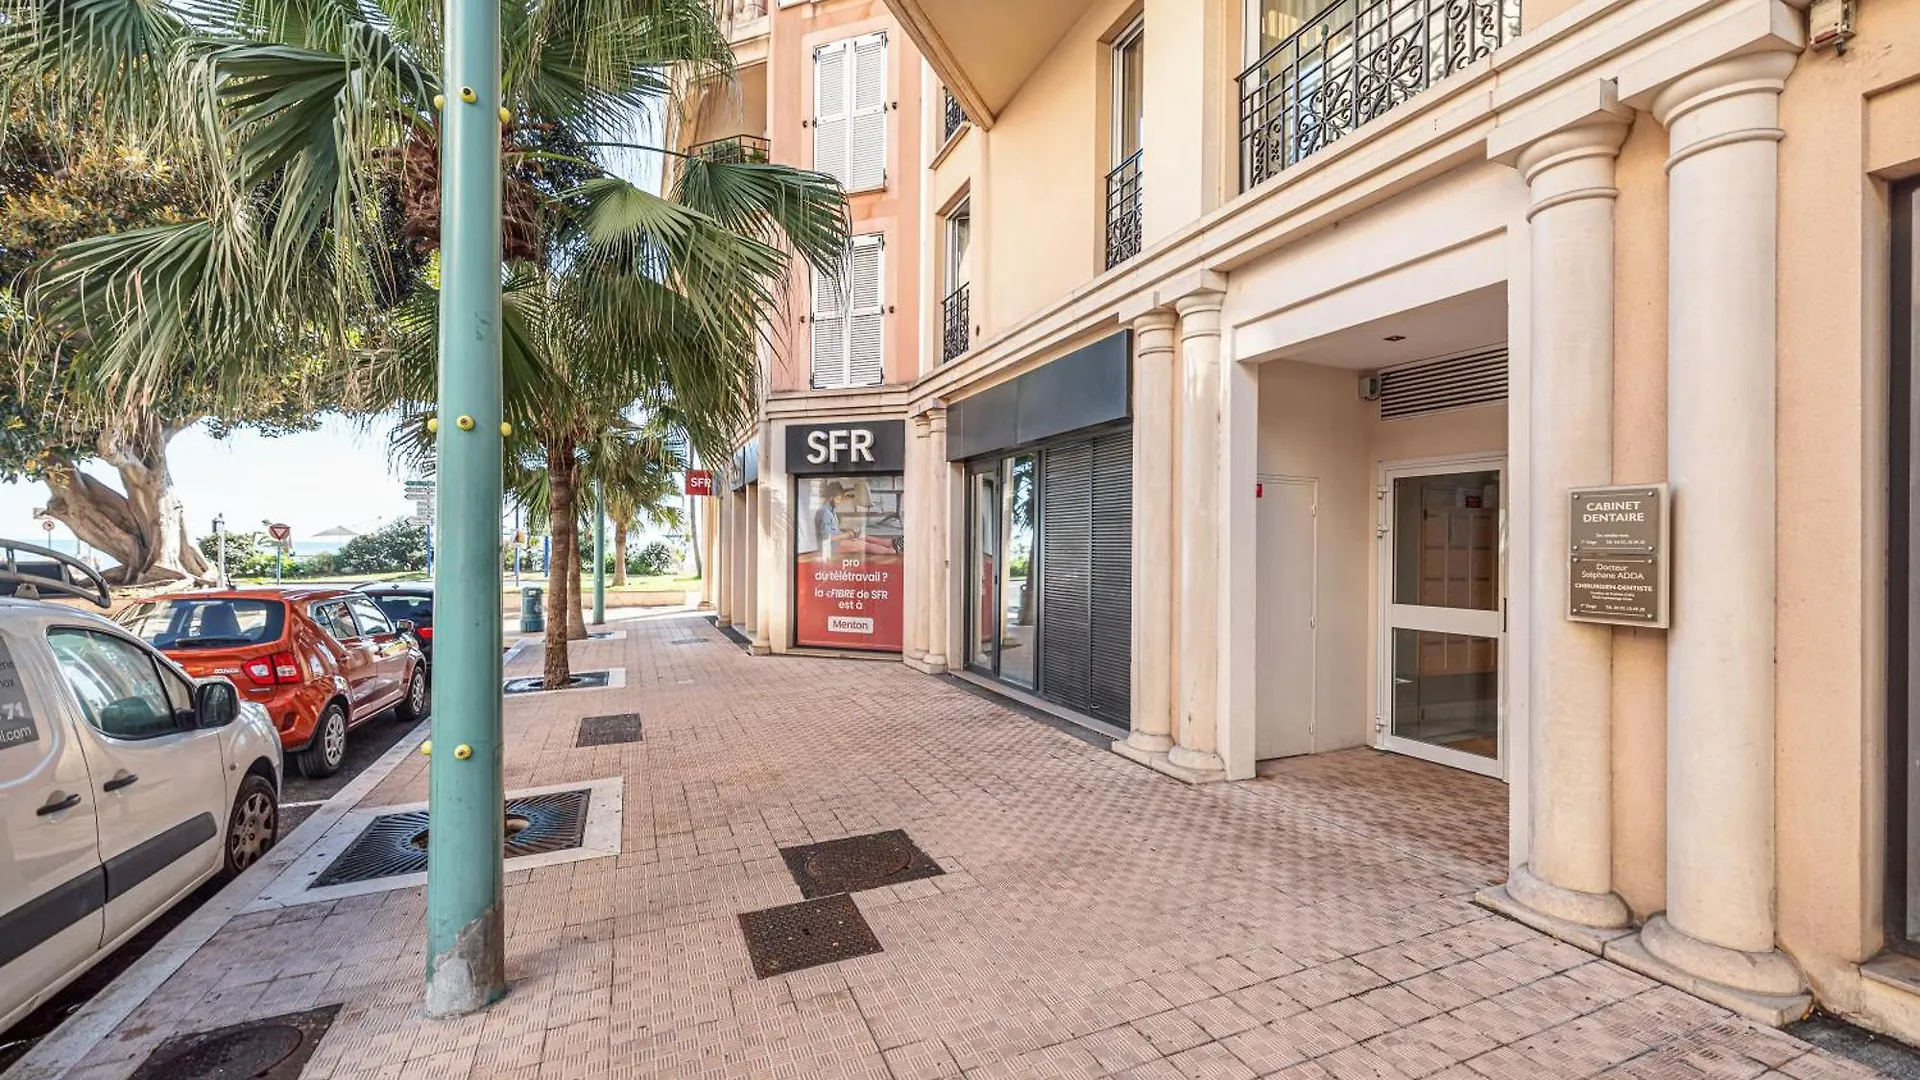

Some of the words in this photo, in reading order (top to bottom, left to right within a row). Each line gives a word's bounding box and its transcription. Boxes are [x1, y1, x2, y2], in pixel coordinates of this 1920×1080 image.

[807, 429, 874, 464] SFR
[690, 477, 711, 488] SFR
[1586, 501, 1641, 511] CABINET
[1583, 512, 1644, 523] DENTAIRE
[842, 559, 859, 570] pro
[1596, 563, 1629, 571] Docteur
[815, 570, 828, 580] du
[829, 570, 881, 581] télétravail
[1617, 571, 1645, 580] ADDA
[814, 588, 824, 597] la
[857, 589, 870, 598] de
[871, 590, 888, 600] SFR
[838, 600, 854, 610] est
[832, 618, 869, 630] Menton
